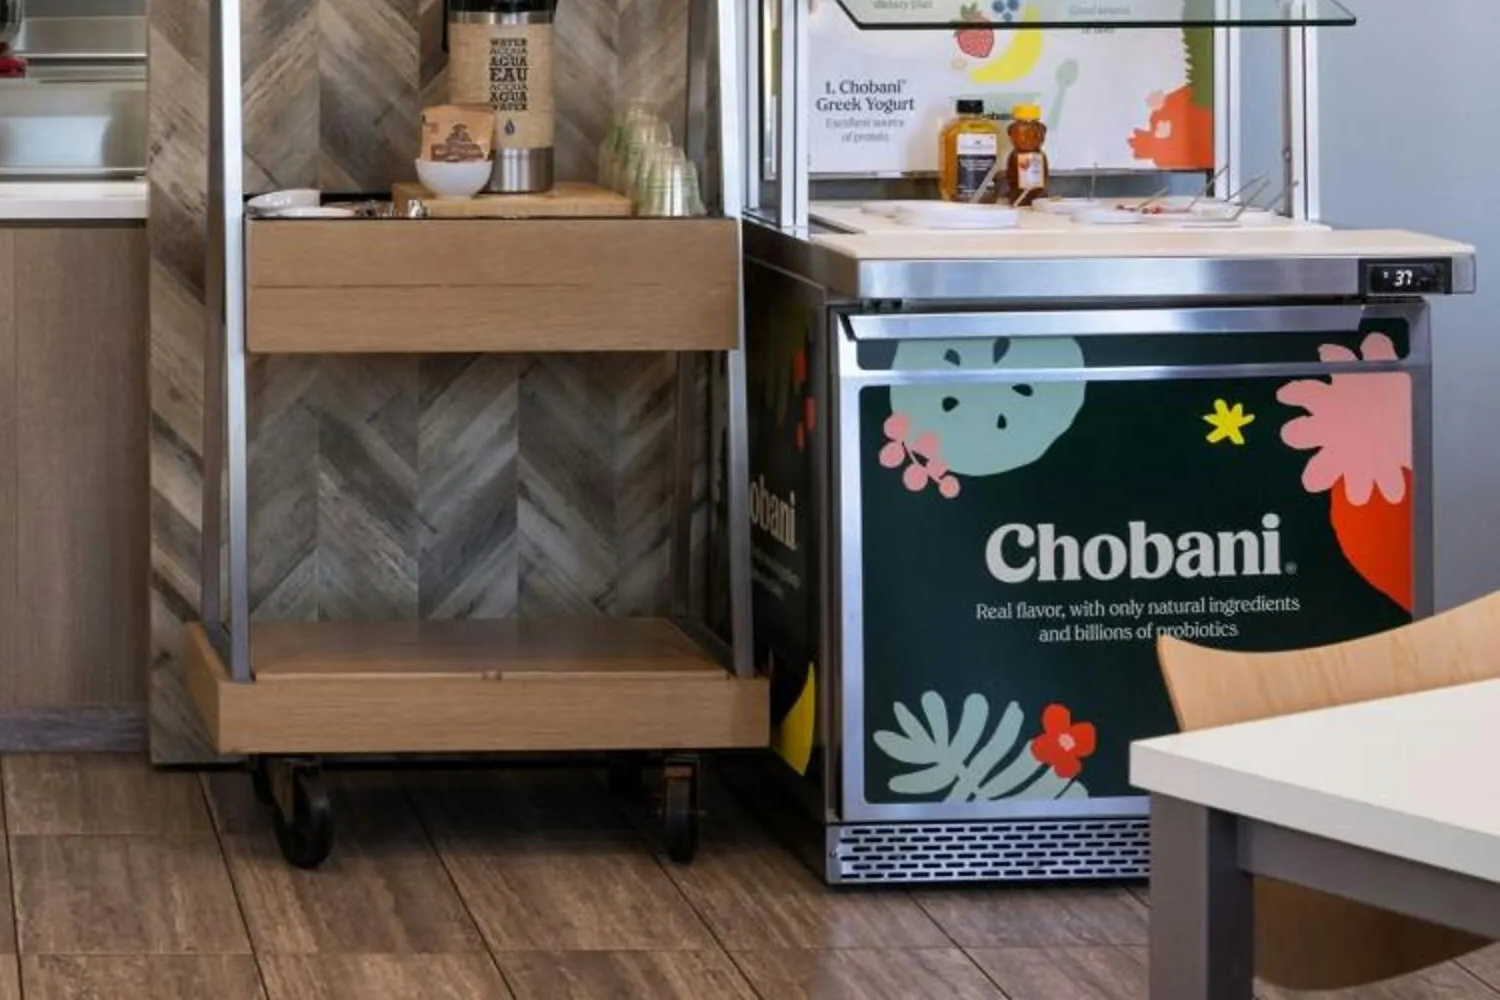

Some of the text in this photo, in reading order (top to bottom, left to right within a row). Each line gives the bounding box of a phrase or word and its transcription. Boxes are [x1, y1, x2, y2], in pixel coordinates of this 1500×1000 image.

[489, 67, 529, 82] EAU
[815, 97, 915, 115] Greek Yogurt
[1395, 269, 1413, 286] 37
[975, 594, 1301, 620] Real flavor, with only natural ingredients
[1038, 625, 1072, 643] and
[1073, 622, 1133, 642] billions
[1135, 621, 1153, 640] of
